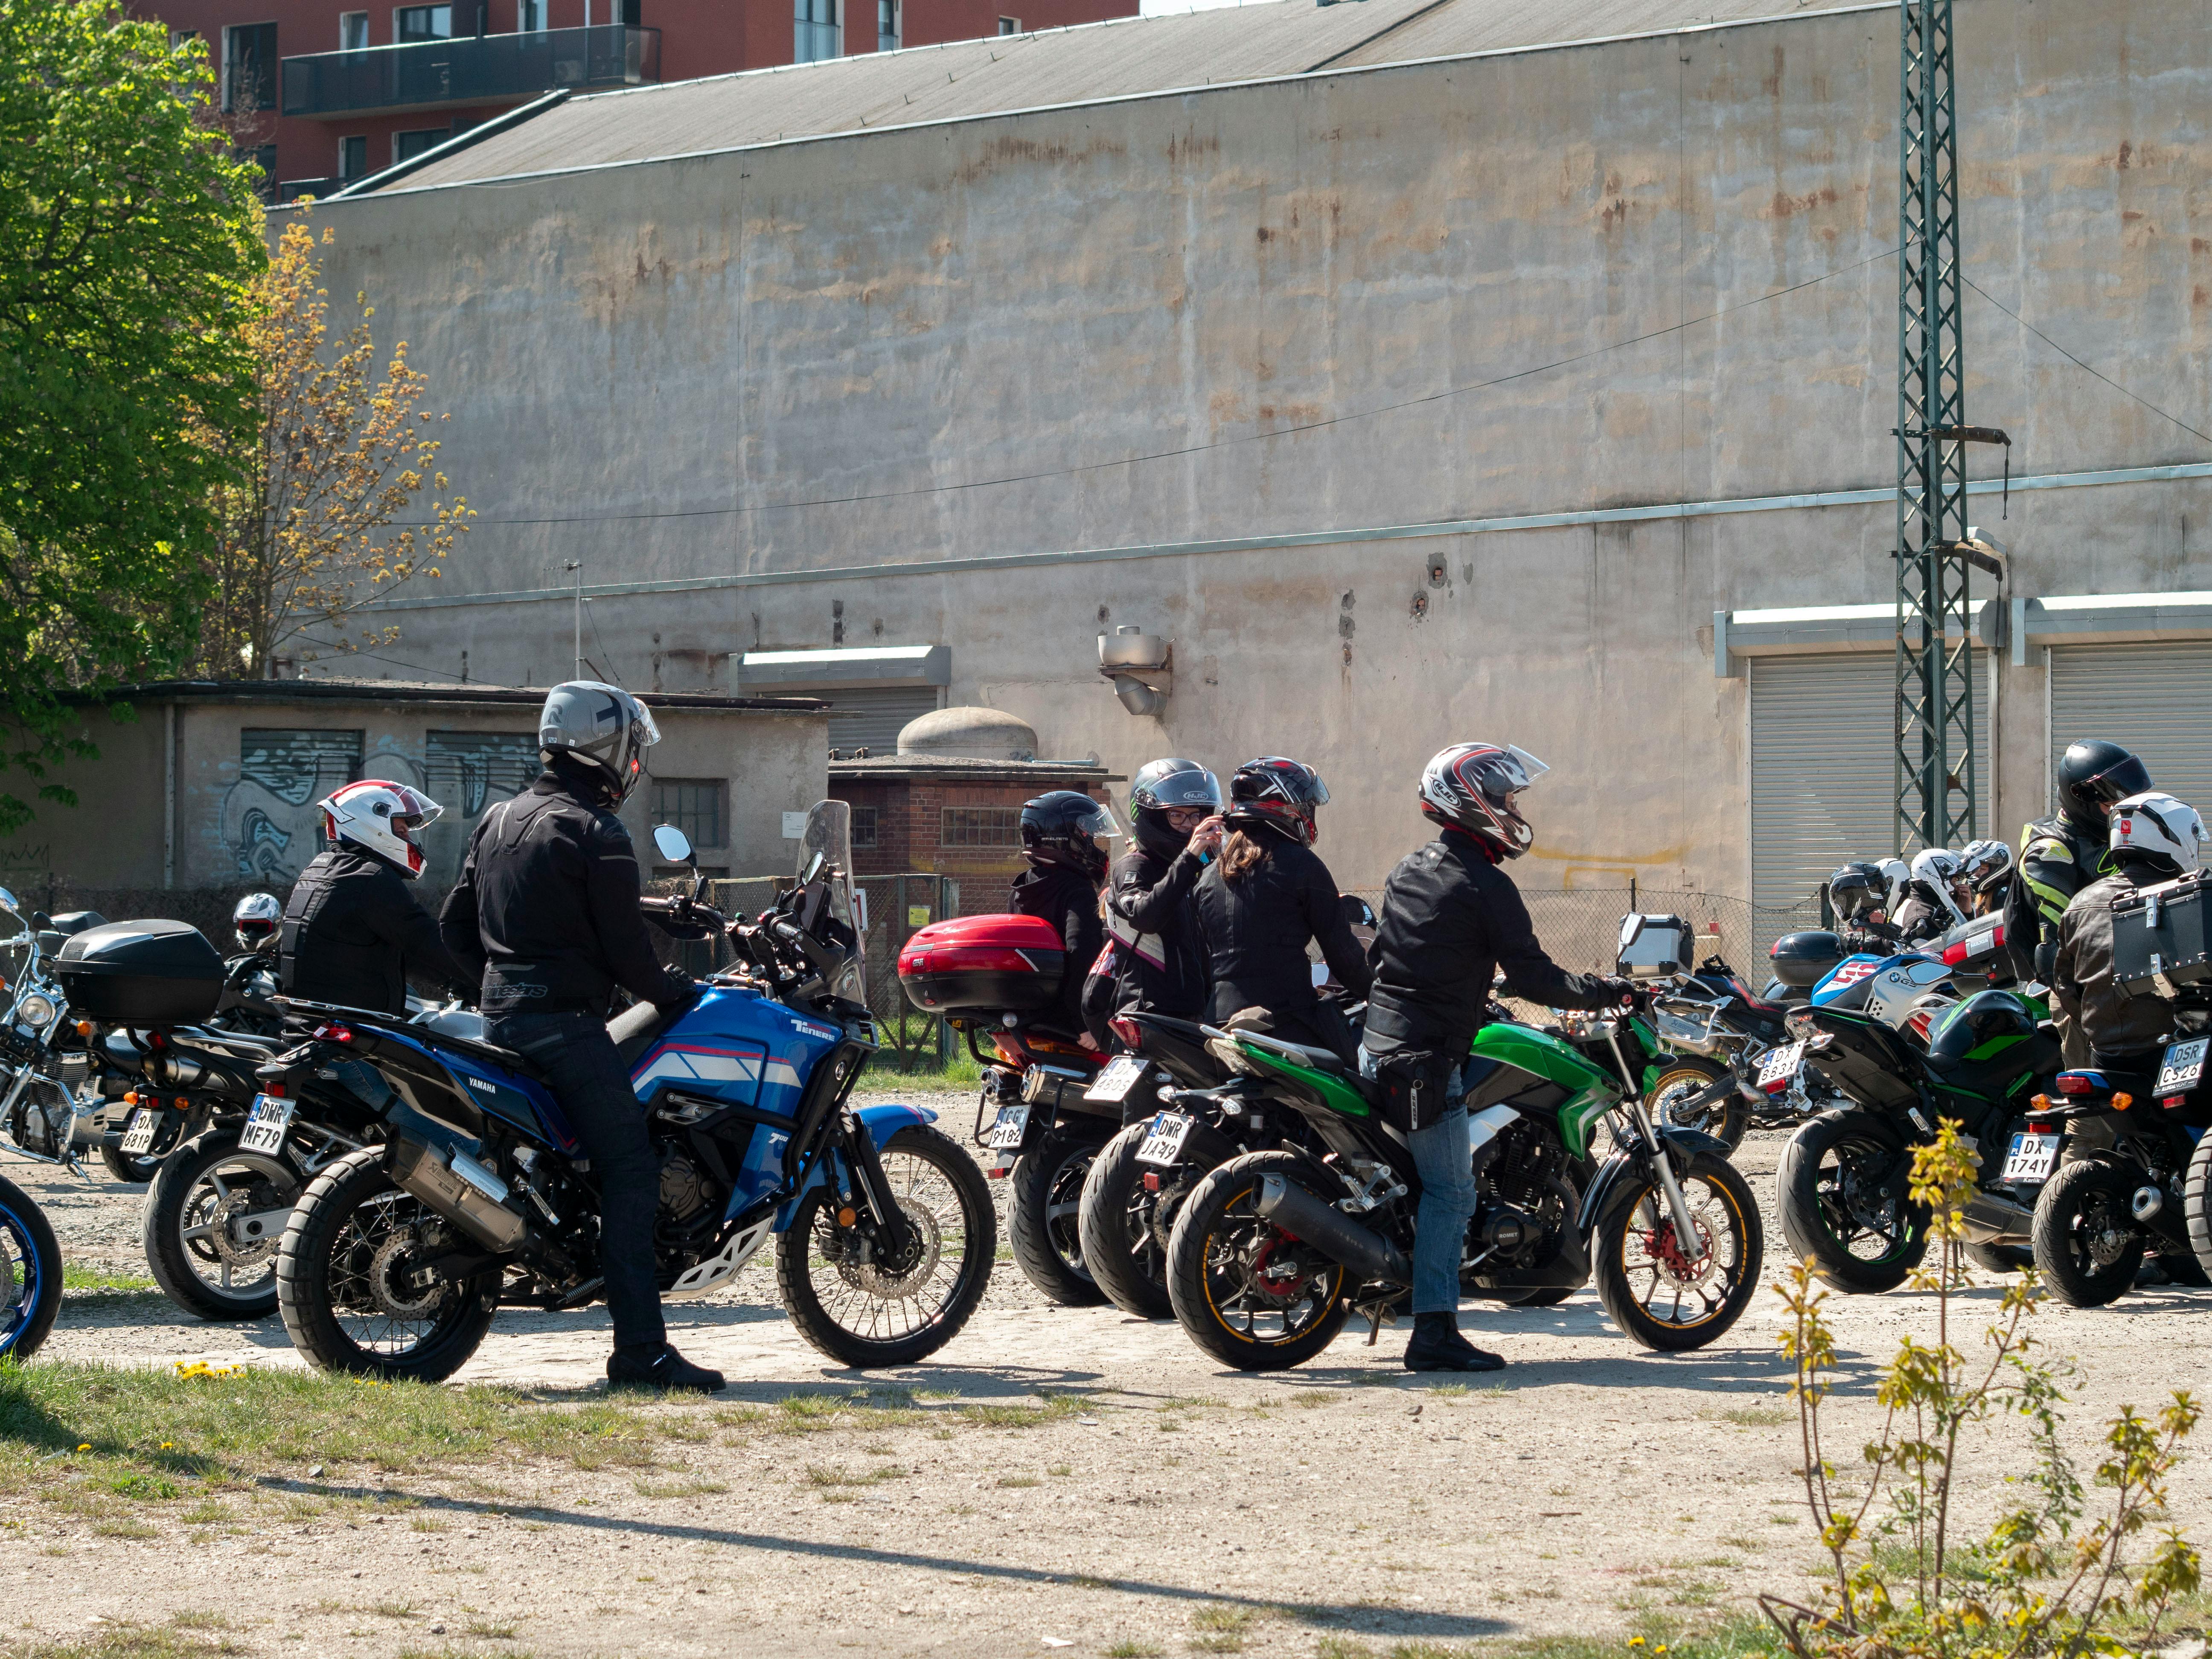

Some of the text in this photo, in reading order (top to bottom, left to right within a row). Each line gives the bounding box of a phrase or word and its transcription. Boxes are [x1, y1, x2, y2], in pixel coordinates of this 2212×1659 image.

[1435, 783, 1457, 802] HJC
[1971, 939, 1988, 948] MAXIA
[1901, 978, 1918, 987] GS
[1775, 1046, 1794, 1062] DX
[2174, 1045, 2199, 1063] DSR
[1761, 1059, 1796, 1081] 883X
[2163, 1062, 2200, 1083] CS26
[469, 1077, 495, 1094] YAMAHA
[250, 1110, 259, 1120] PL
[259, 1102, 285, 1124] DWR
[1006, 1110, 1020, 1124] CG
[138, 1115, 154, 1130] DX
[1158, 1119, 1182, 1139] DWR
[125, 1133, 150, 1148] 681P
[244, 1125, 281, 1148] MF79
[768, 1132, 789, 1144] 700
[992, 1128, 1021, 1144] 9182
[1141, 1140, 1176, 1159] JA49
[2024, 1140, 2045, 1154] DX
[2011, 1159, 2049, 1173] 174Y
